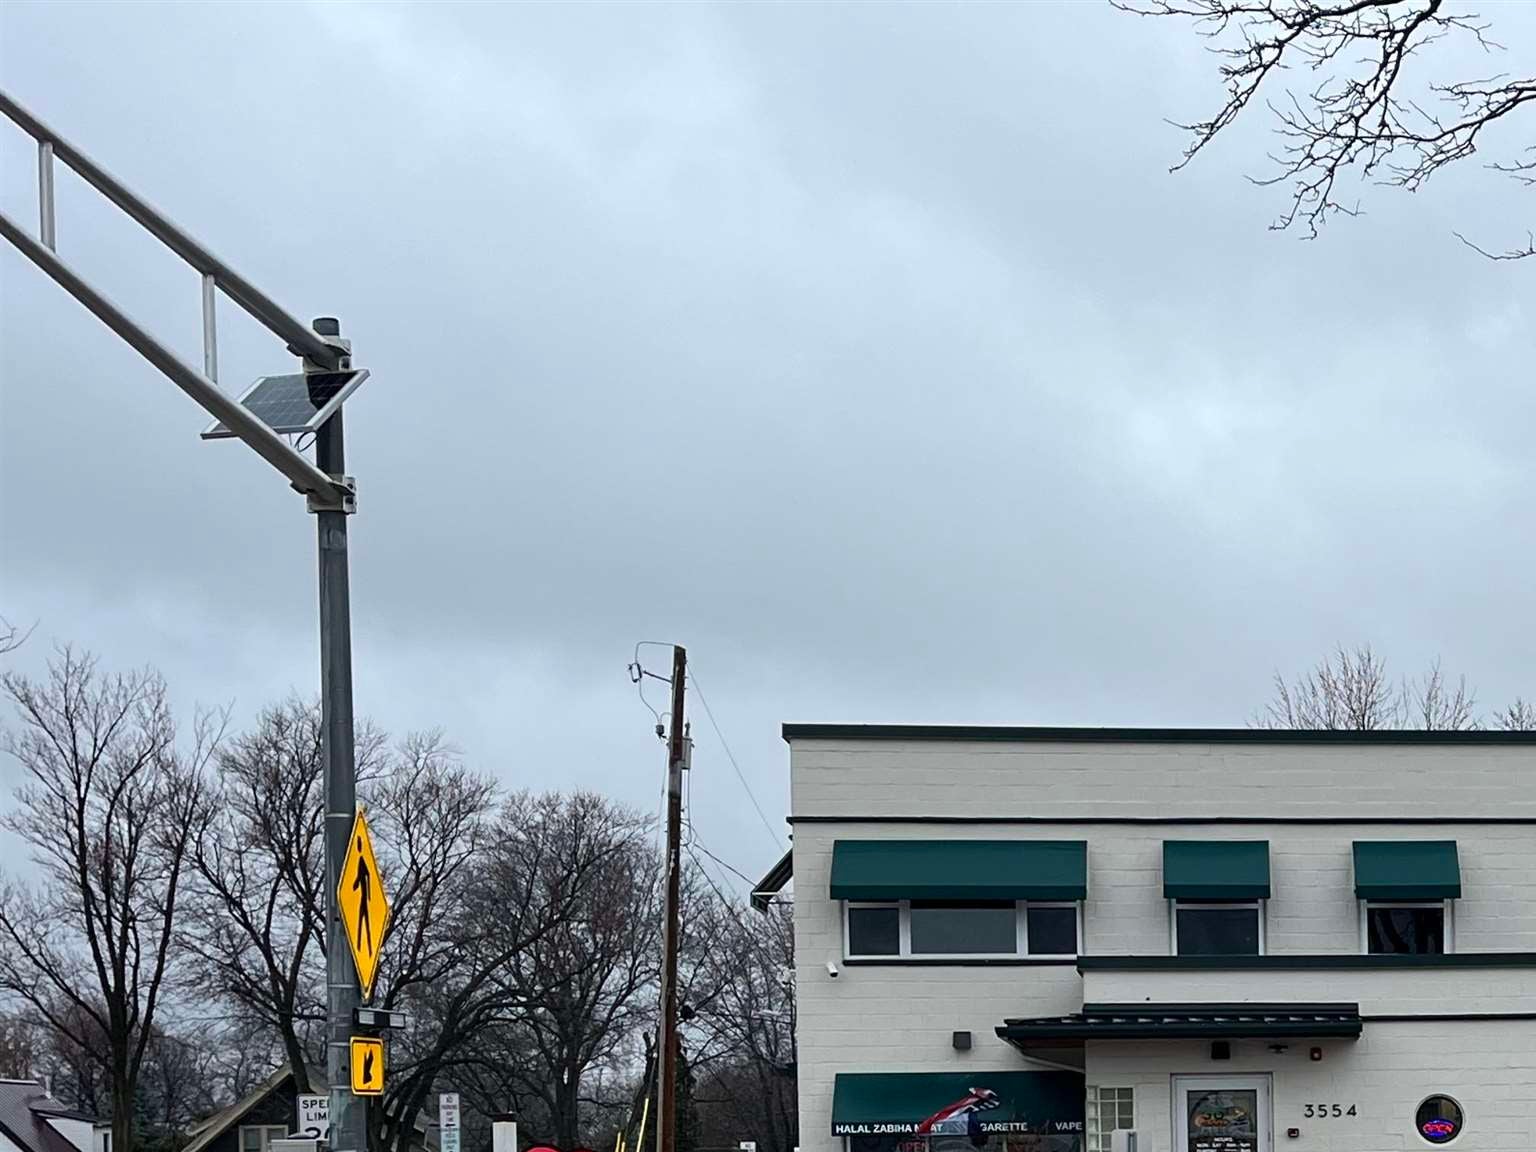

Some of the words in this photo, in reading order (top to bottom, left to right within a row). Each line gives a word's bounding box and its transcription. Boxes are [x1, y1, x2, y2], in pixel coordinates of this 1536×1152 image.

[302, 1099, 329, 1109] SPE
[306, 1112, 330, 1121] LIM
[1304, 1104, 1357, 1118] 3554
[836, 1124, 871, 1133] HALAL
[873, 1123, 912, 1133] ZABIHA
[1055, 1122, 1083, 1131] VAPE
[1422, 1122, 1454, 1135] OPEN
